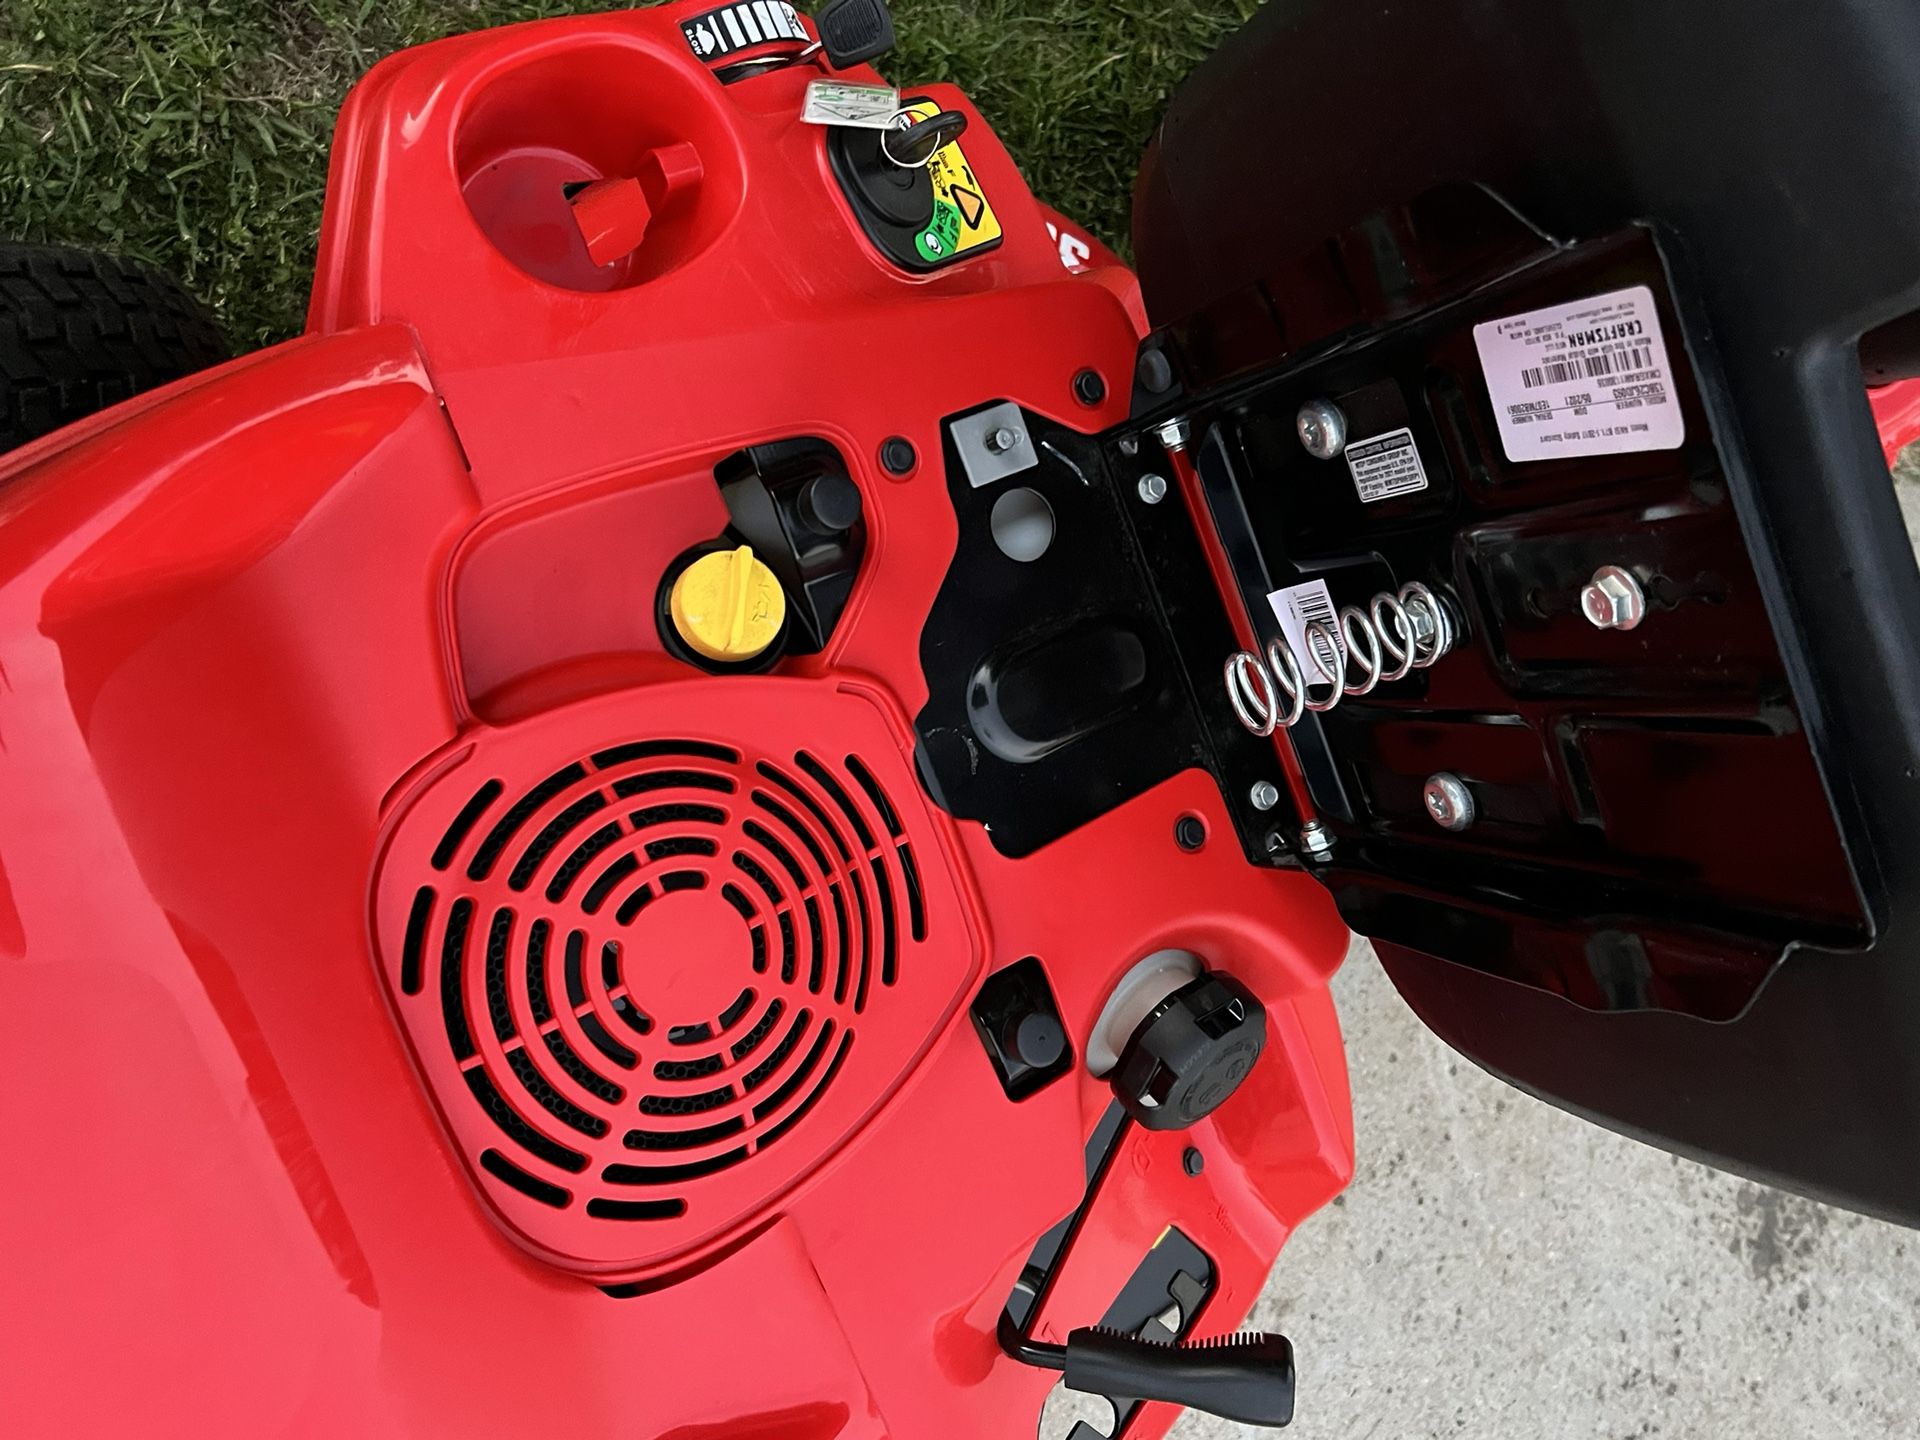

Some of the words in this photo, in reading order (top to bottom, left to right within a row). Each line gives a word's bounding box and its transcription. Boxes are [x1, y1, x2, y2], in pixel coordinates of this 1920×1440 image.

[684, 28, 704, 56] SLOW
[1566, 319, 1642, 348] CRAFTSMAN
[1600, 344, 1613, 353] USA
[1563, 393, 1591, 406] 05/2021
[1615, 399, 1642, 409] NUMBER
[1644, 395, 1667, 404] MODEL
[1511, 415, 1533, 424] NUMBER
[1534, 412, 1553, 421] SERIAL
[1539, 433, 1562, 443] Standard
[1563, 430, 1580, 440] Safety
